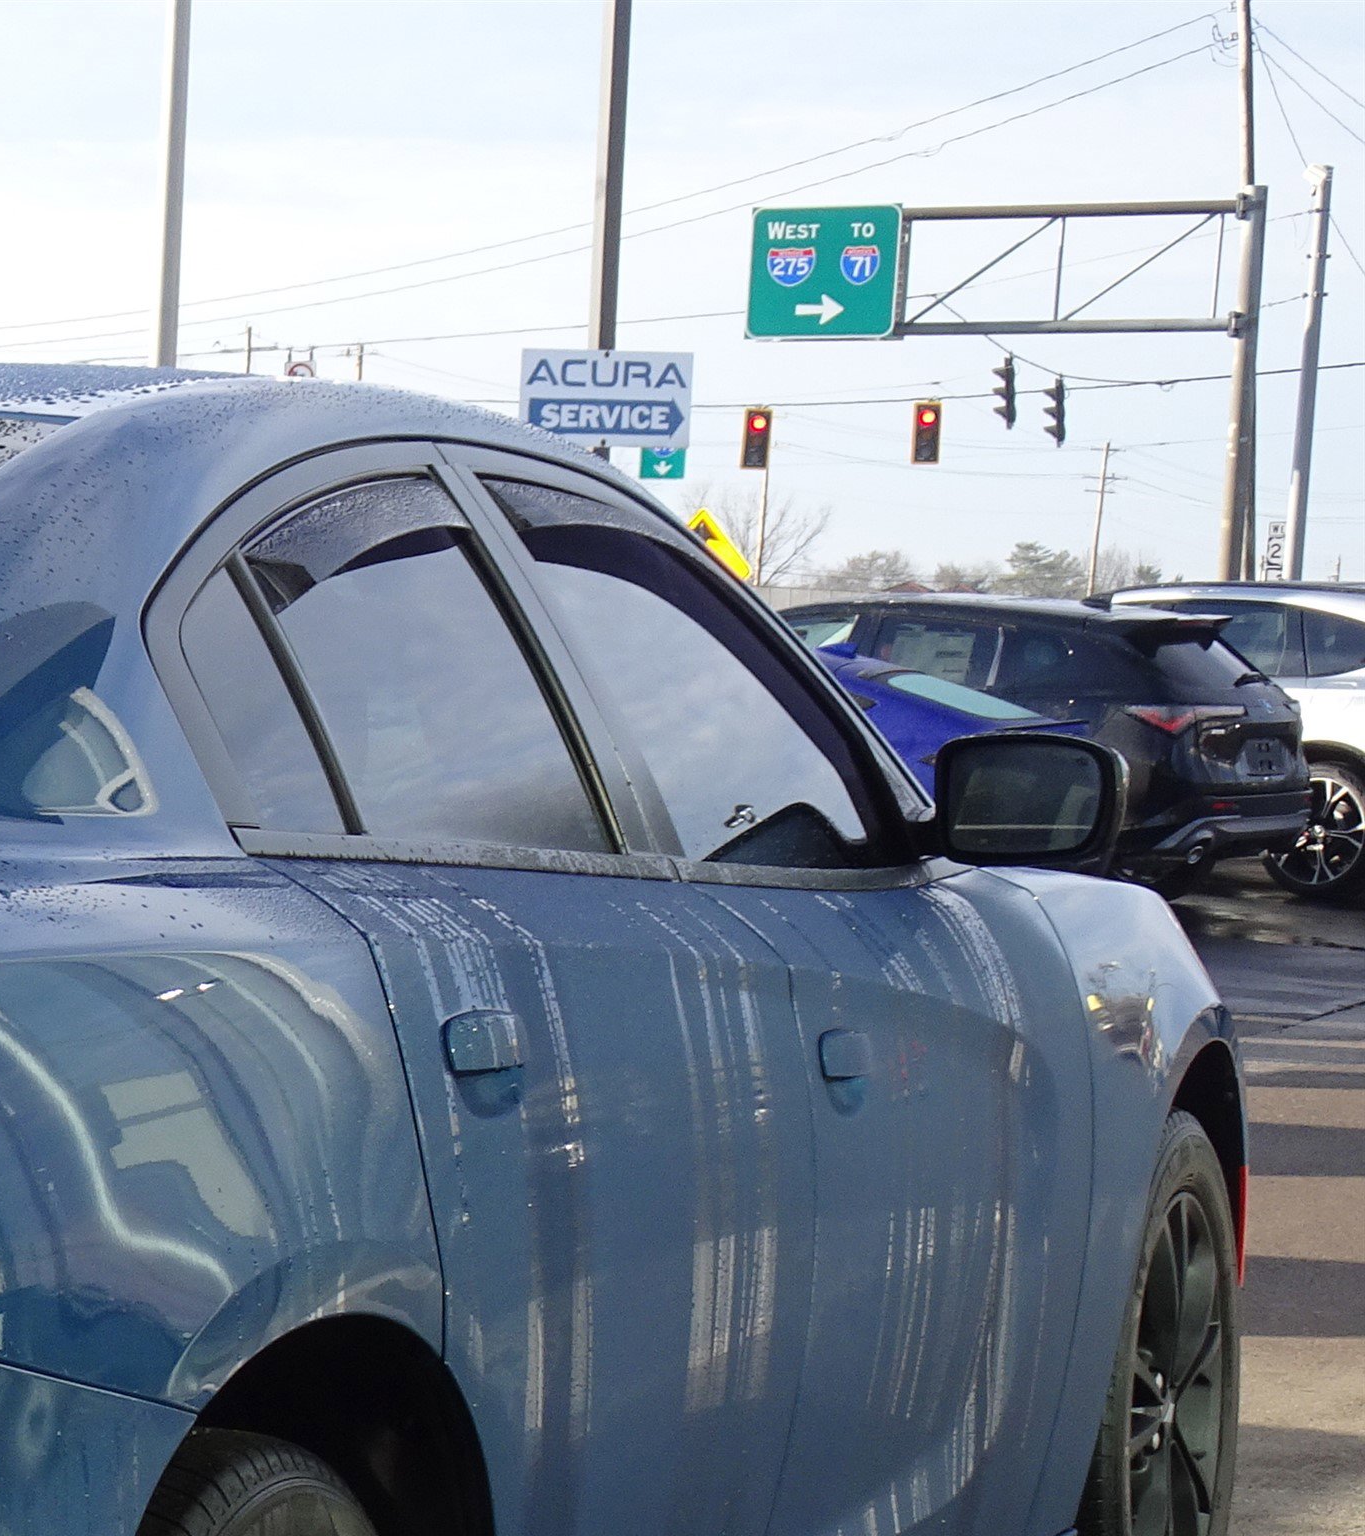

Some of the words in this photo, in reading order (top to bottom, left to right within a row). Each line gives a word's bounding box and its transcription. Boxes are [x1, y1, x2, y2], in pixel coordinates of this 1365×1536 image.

[767, 221, 820, 240] WEST
[850, 222, 876, 238] TO
[772, 257, 810, 277] 275
[849, 256, 872, 278] 71
[526, 358, 687, 389] ACURA
[540, 403, 671, 431] SERVICE
